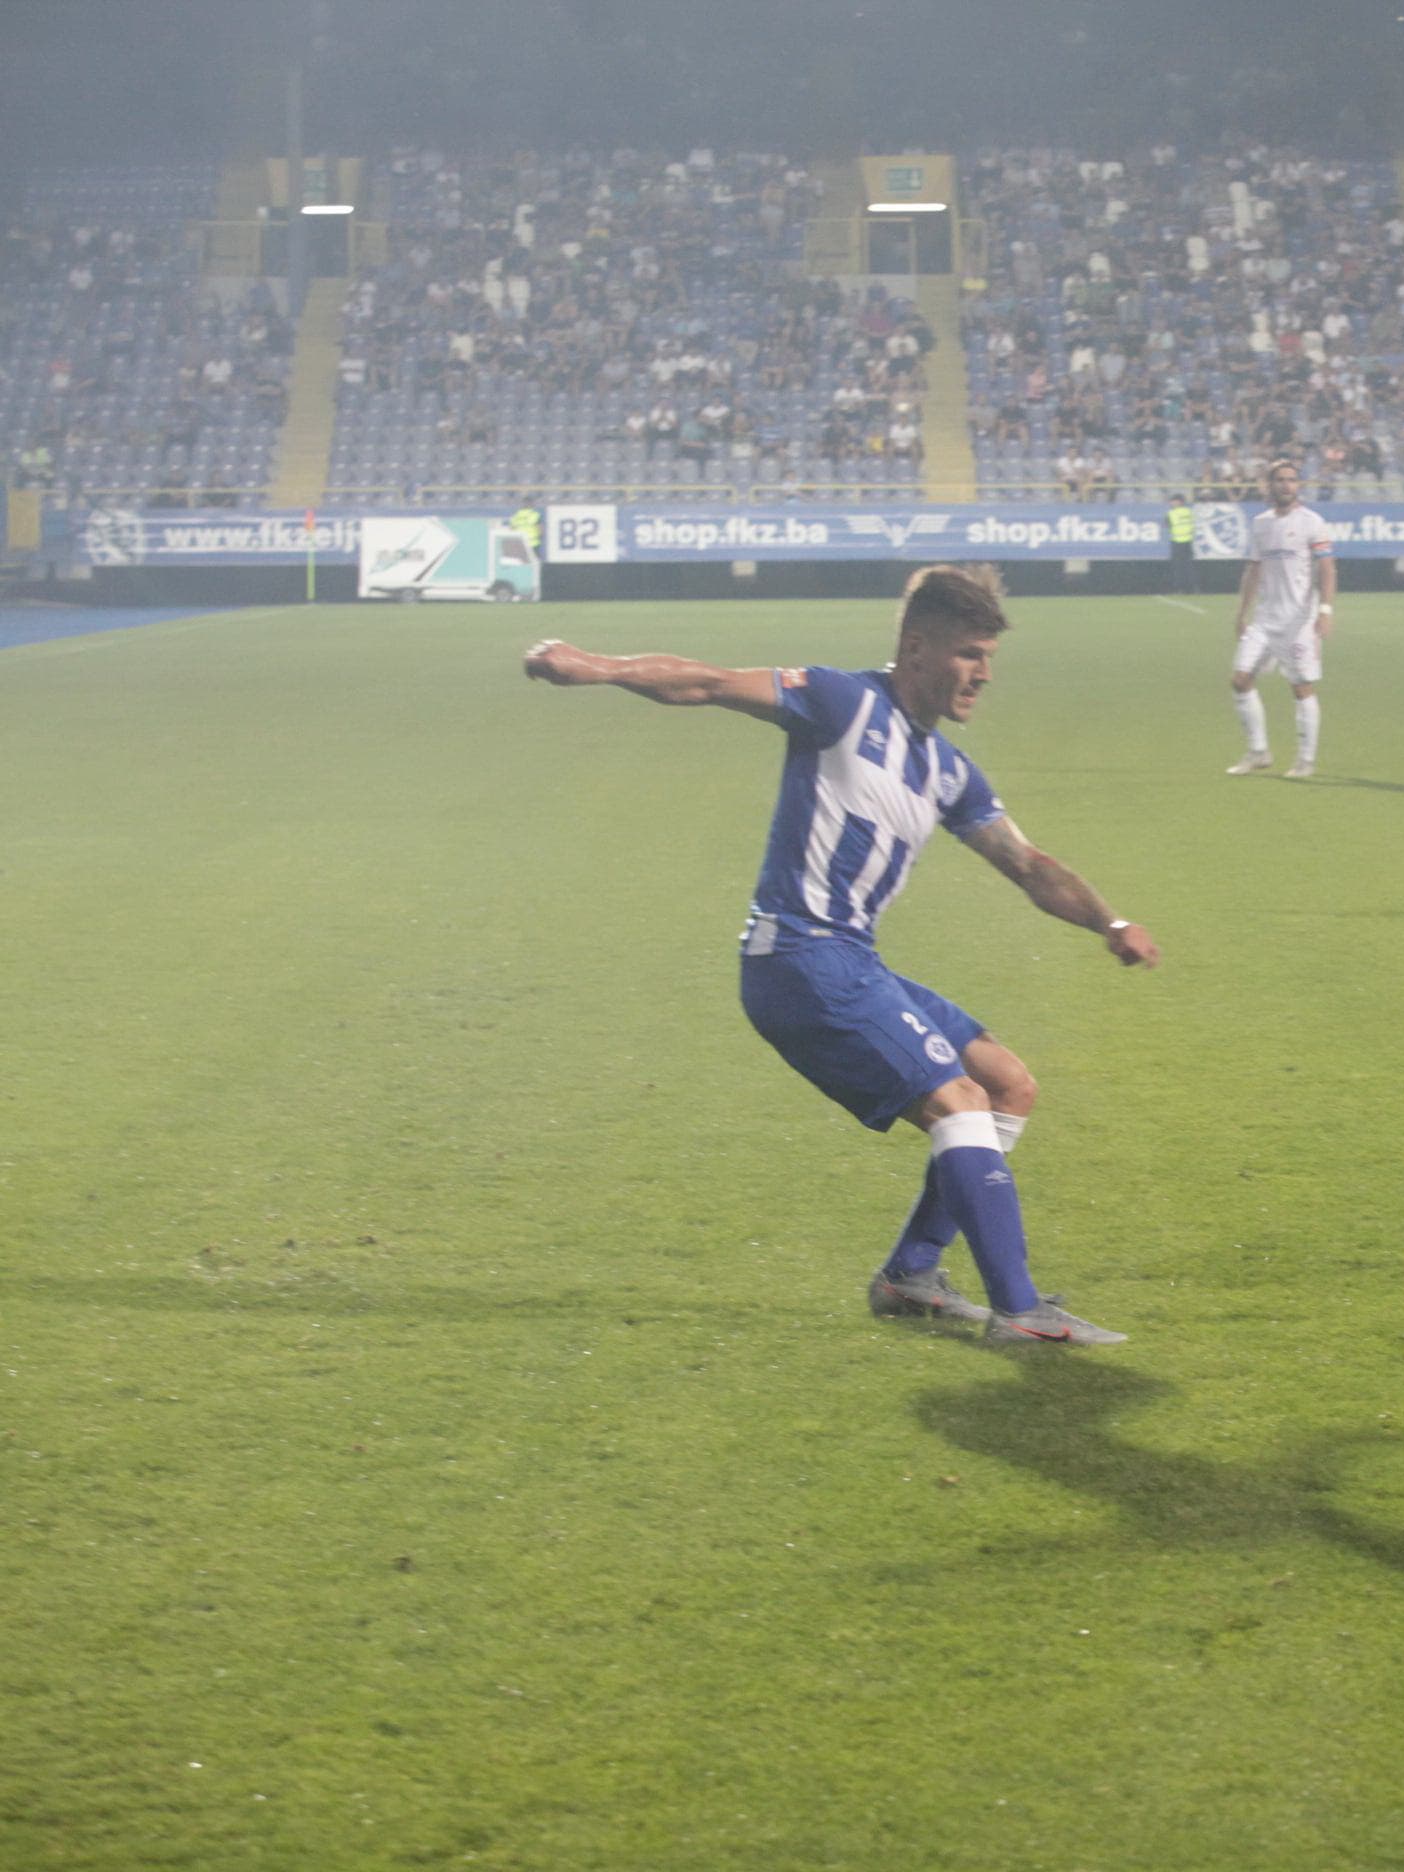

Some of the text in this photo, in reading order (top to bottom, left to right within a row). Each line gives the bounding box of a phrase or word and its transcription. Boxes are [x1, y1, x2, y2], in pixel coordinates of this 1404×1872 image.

[164, 520, 361, 553] www.fkzelj
[559, 519, 600, 549] B2
[634, 517, 828, 550] shop.fkz.ba
[966, 516, 1160, 548] shop.fkz.ba
